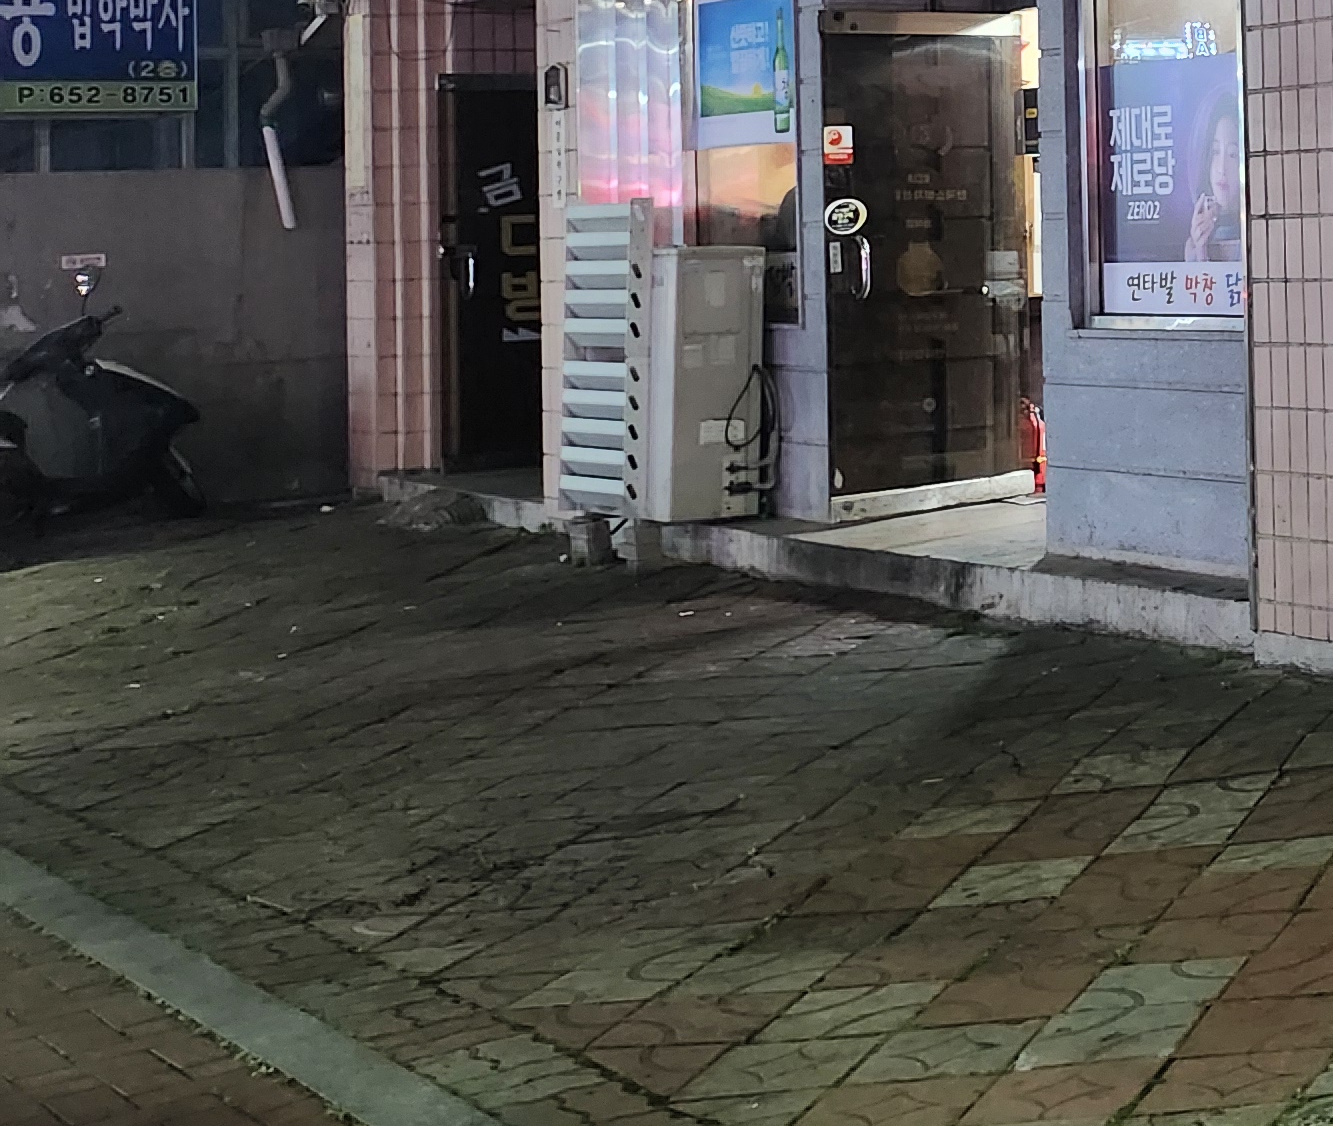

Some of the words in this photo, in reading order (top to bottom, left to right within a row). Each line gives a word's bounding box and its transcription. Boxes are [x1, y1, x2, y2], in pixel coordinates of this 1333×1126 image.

[1109, 105, 1174, 150] 제대로
[1110, 149, 1176, 196] 제로당
[1127, 201, 1160, 220] ZERO2
[1127, 271, 1177, 304] 연타발
[1185, 273, 1216, 306] 막창
